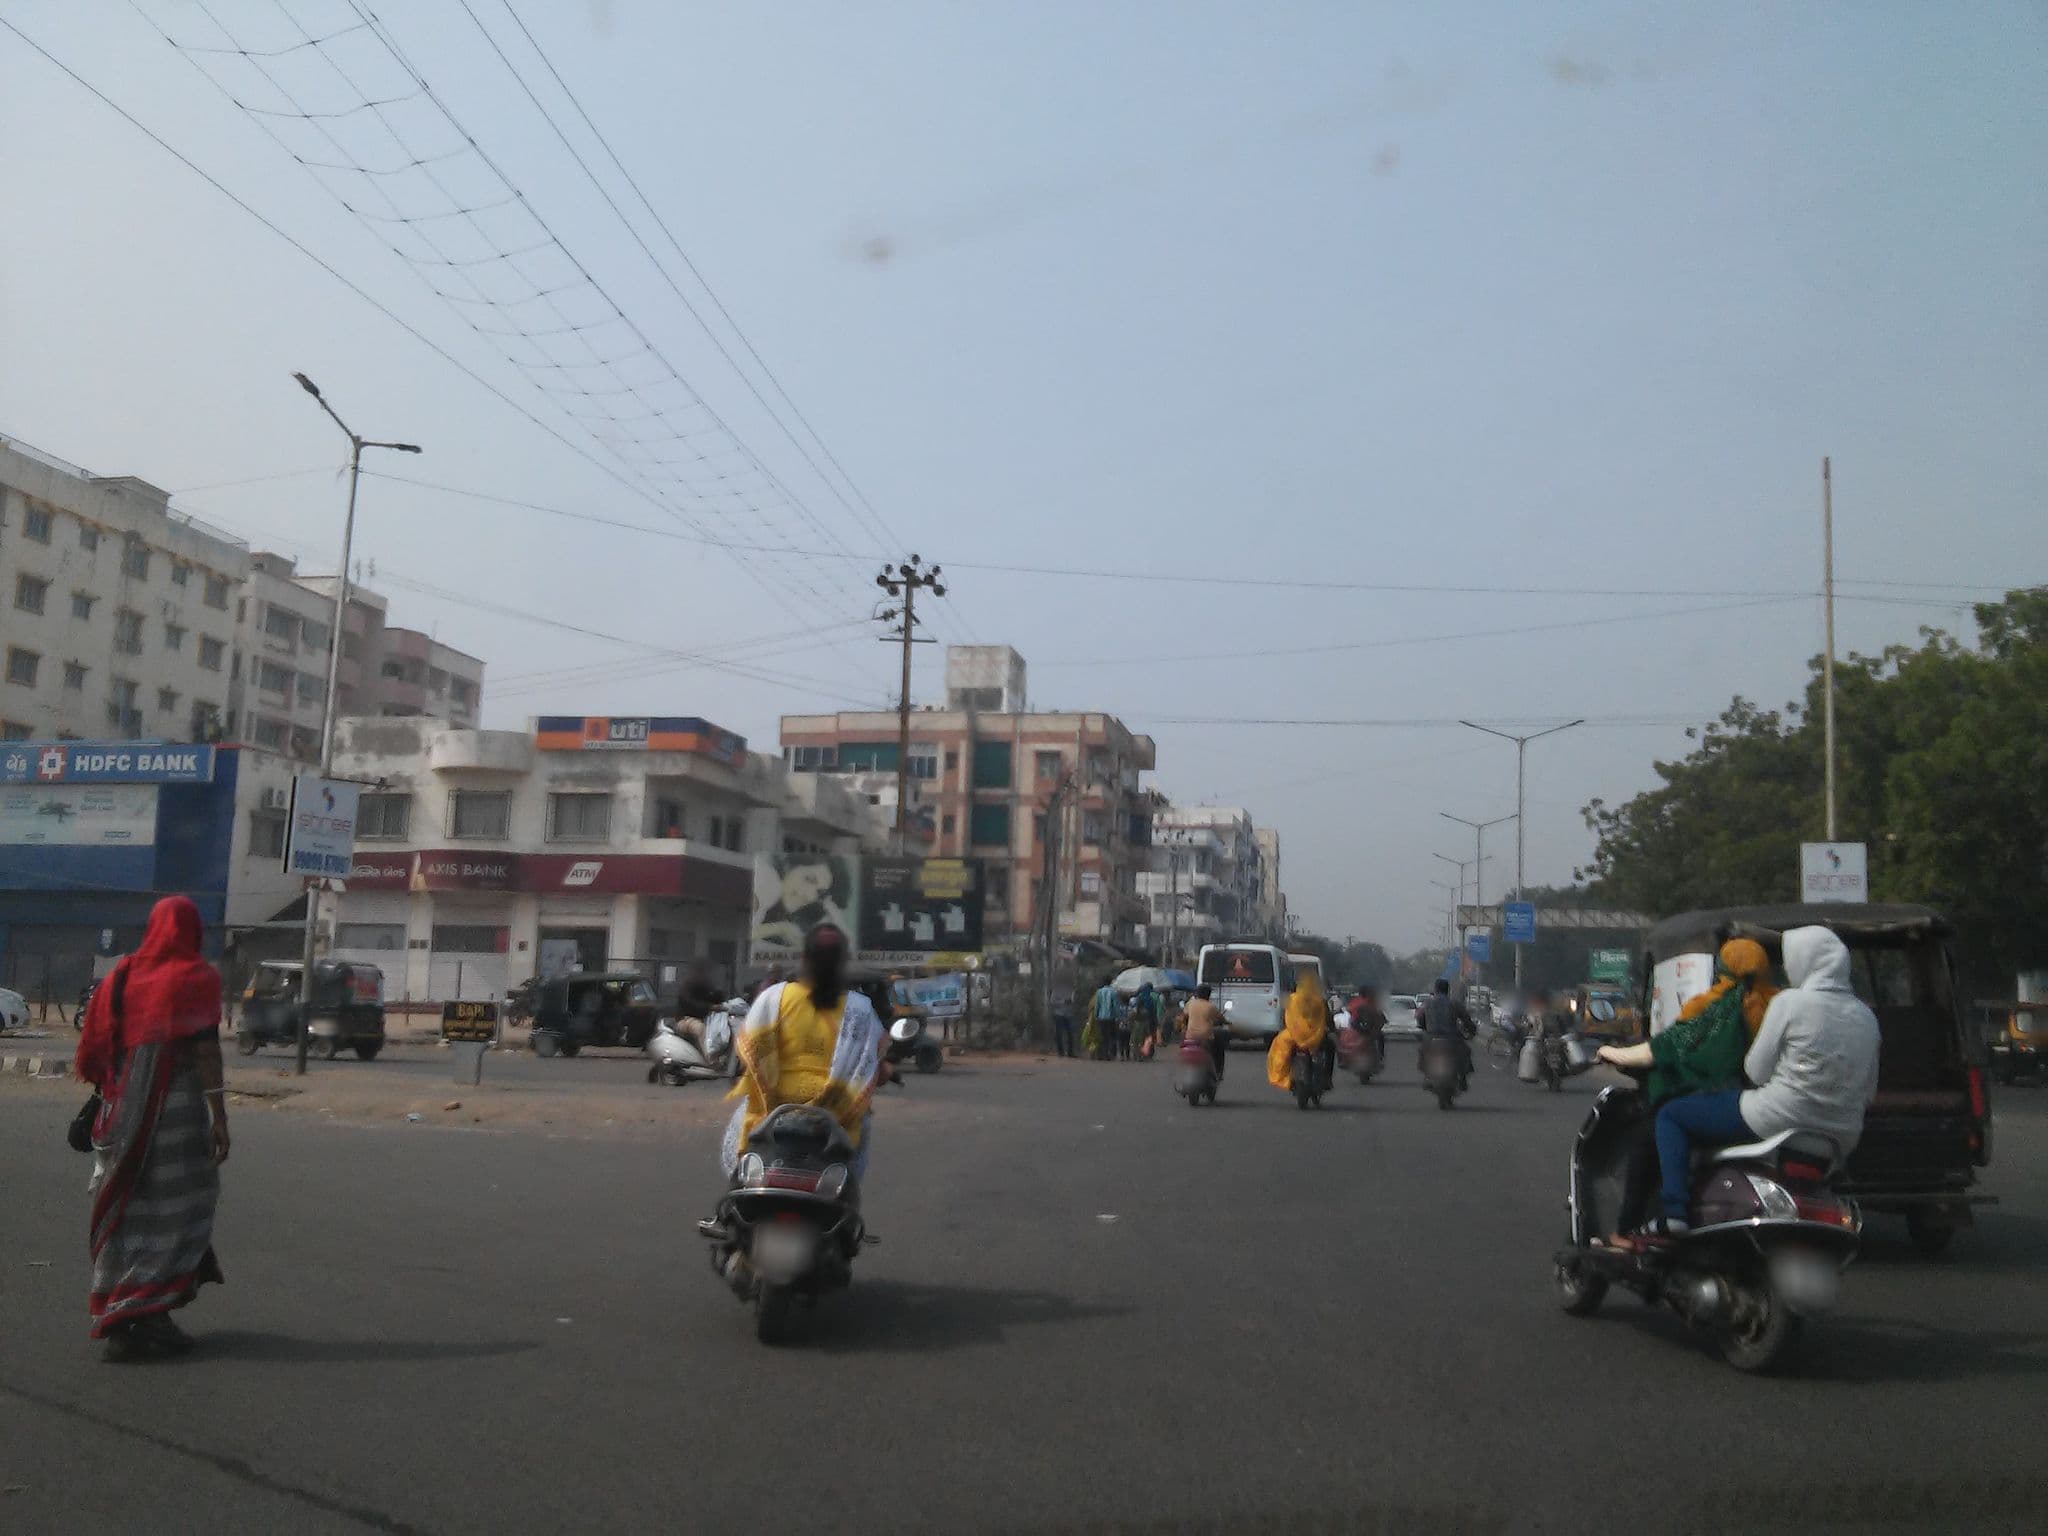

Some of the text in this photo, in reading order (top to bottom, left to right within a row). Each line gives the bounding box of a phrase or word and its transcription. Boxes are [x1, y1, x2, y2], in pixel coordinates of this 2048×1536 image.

[74, 754, 198, 771] HDFC BANK
[427, 863, 507, 876] AXIS BANK
[569, 868, 596, 878] ATM
